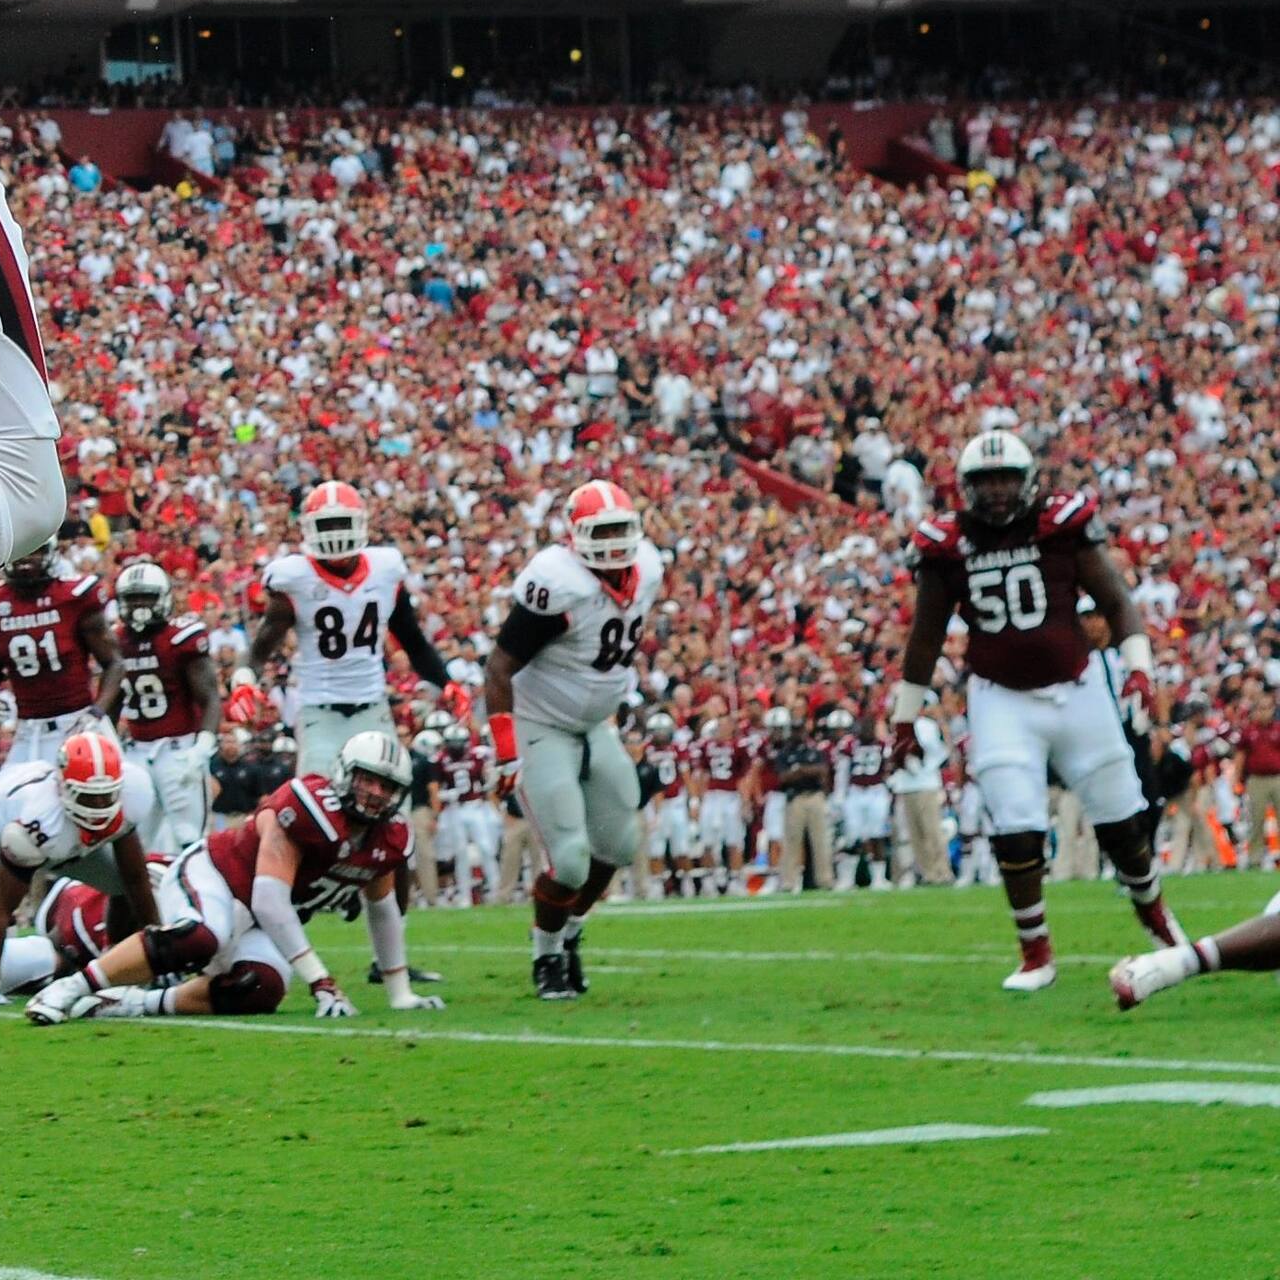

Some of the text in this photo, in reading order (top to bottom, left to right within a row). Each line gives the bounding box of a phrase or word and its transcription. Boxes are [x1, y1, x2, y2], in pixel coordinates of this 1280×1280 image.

[525, 580, 551, 610] 88
[968, 563, 1048, 634] 50
[8, 630, 62, 678] 81
[313, 601, 379, 660] 84
